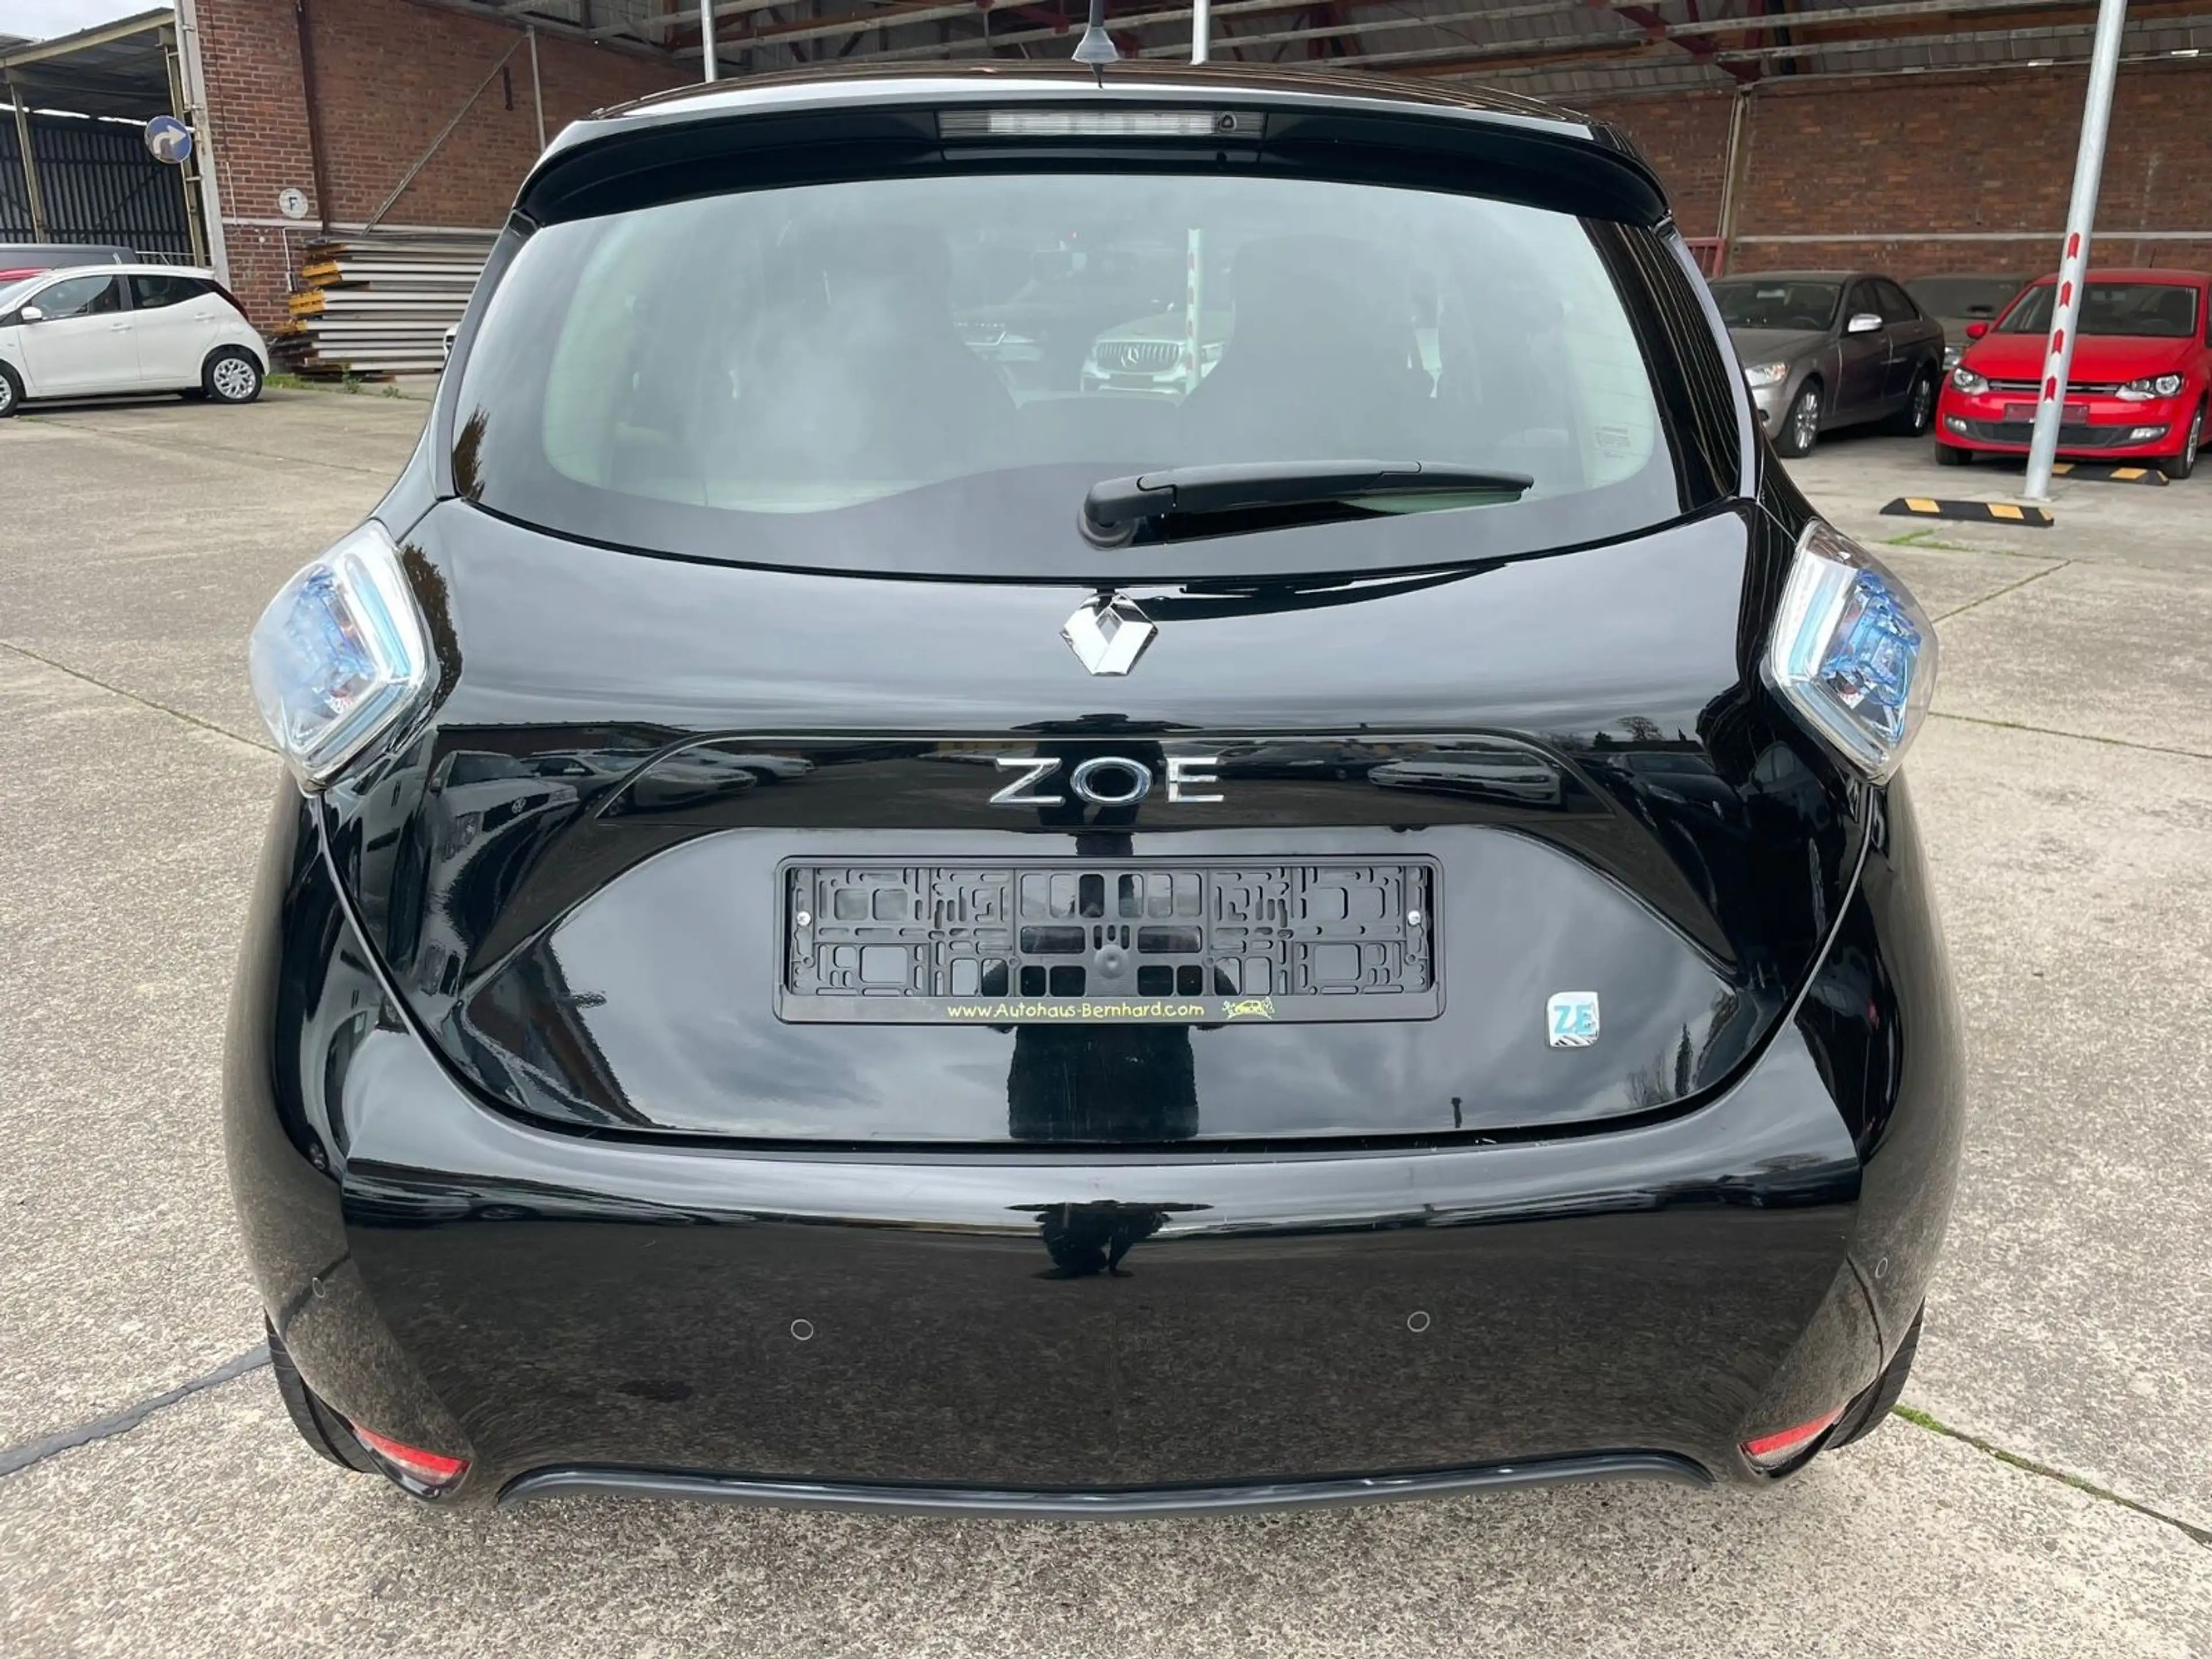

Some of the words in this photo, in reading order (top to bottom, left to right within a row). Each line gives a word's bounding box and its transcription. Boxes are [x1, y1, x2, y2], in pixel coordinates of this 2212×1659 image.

[289, 196, 298, 211] F
[989, 756, 1225, 805] ZOE
[947, 1001, 1205, 1018] www.Autohaus-Bernhard.com
